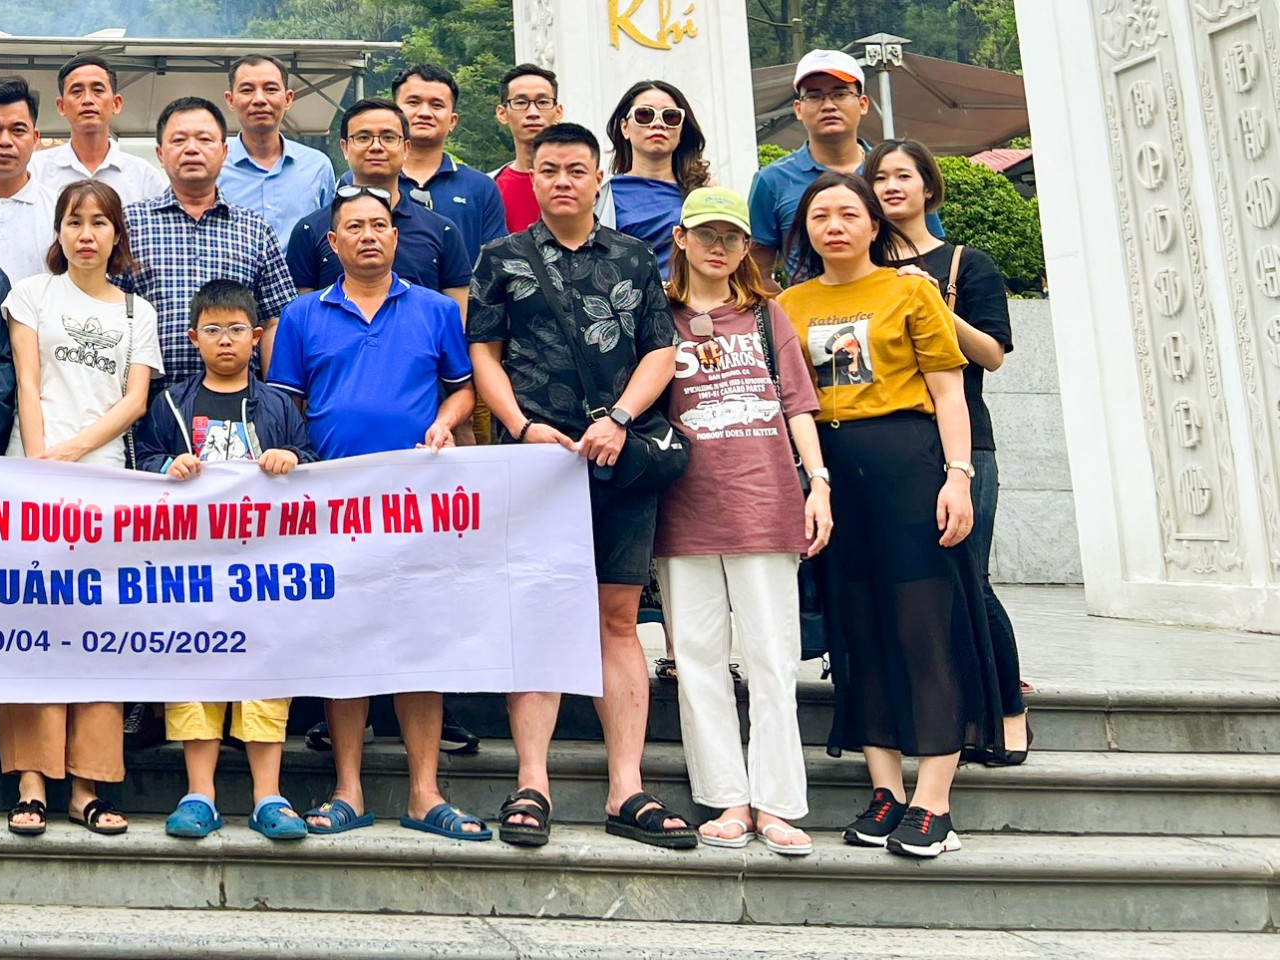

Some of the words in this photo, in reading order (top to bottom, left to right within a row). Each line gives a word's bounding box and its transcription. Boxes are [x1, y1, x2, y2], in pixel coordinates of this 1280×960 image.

[54, 344, 117, 375] adidas
[725, 429, 744, 437] DOES
[22, 497, 102, 550] DƯỢC
[113, 493, 197, 541] PHẨM
[208, 499, 271, 544] VIỆT
[279, 496, 316, 535] HÀ
[328, 497, 371, 541] TẠI
[382, 488, 423, 533] HÀ
[432, 486, 479, 538] NỘI
[118, 561, 213, 604] BÌNH
[228, 563, 334, 602] 3N3Đ
[83, 631, 246, 654] 02/05/2022
